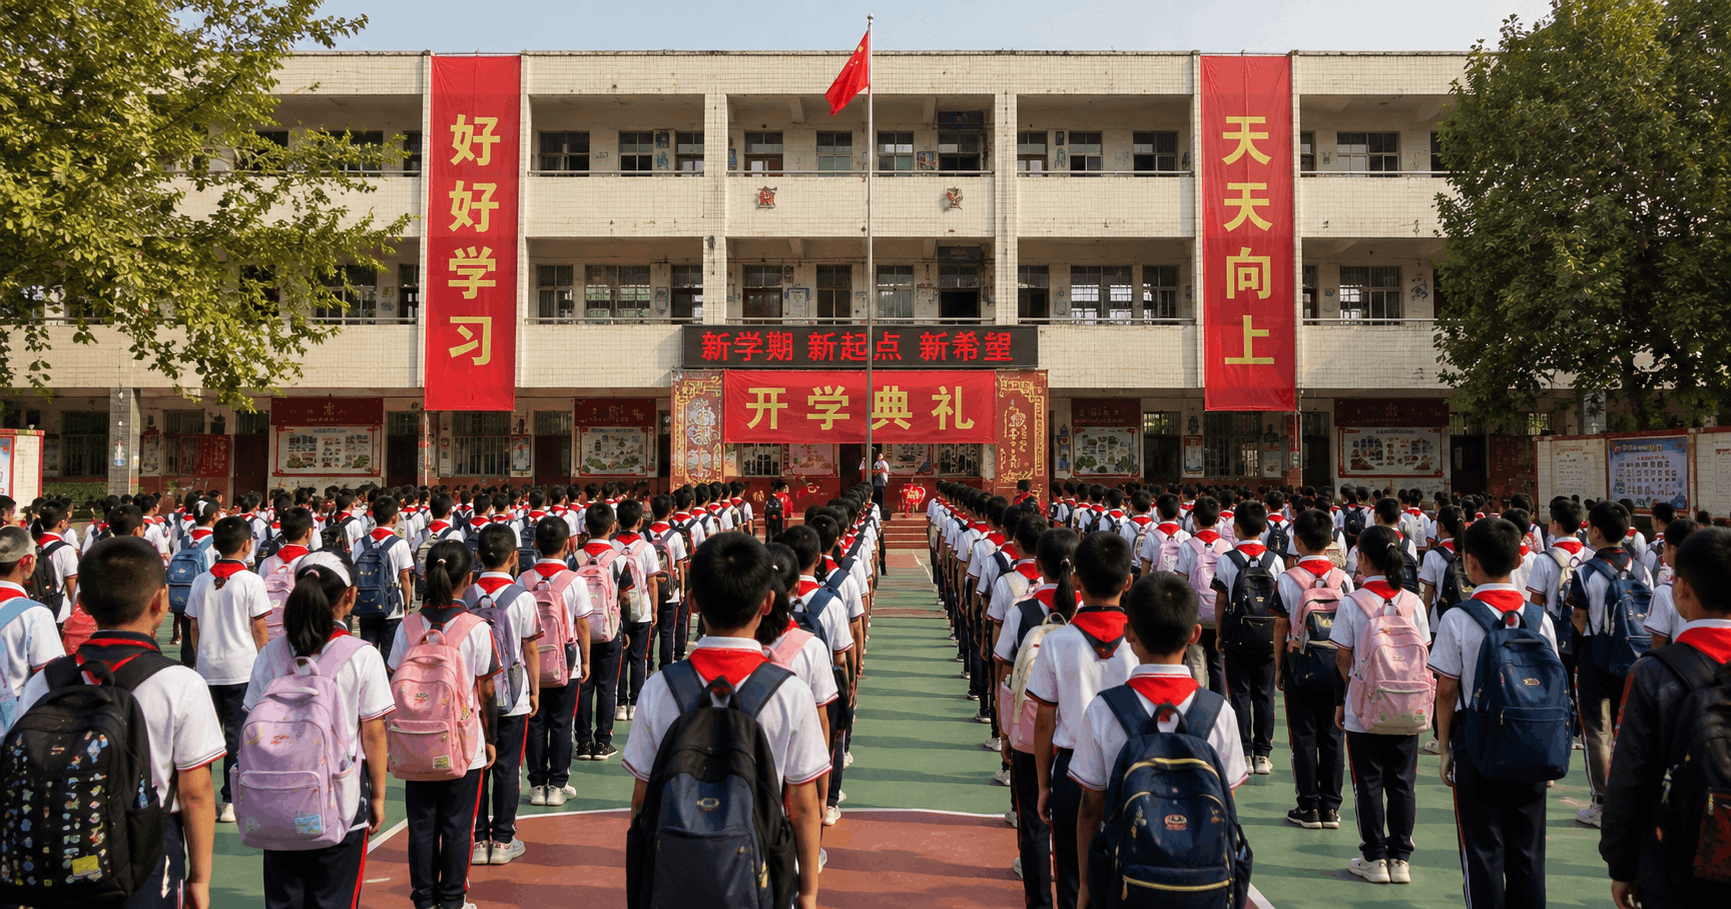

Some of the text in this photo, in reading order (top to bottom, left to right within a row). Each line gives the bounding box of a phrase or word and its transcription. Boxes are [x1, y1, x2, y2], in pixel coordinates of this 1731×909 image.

[449, 114, 501, 366] 好好学习
[1222, 115, 1275, 366] 天天向上
[701, 331, 1013, 362] 新学期 新起点 新希望
[745, 385, 975, 431] 开学典礼
